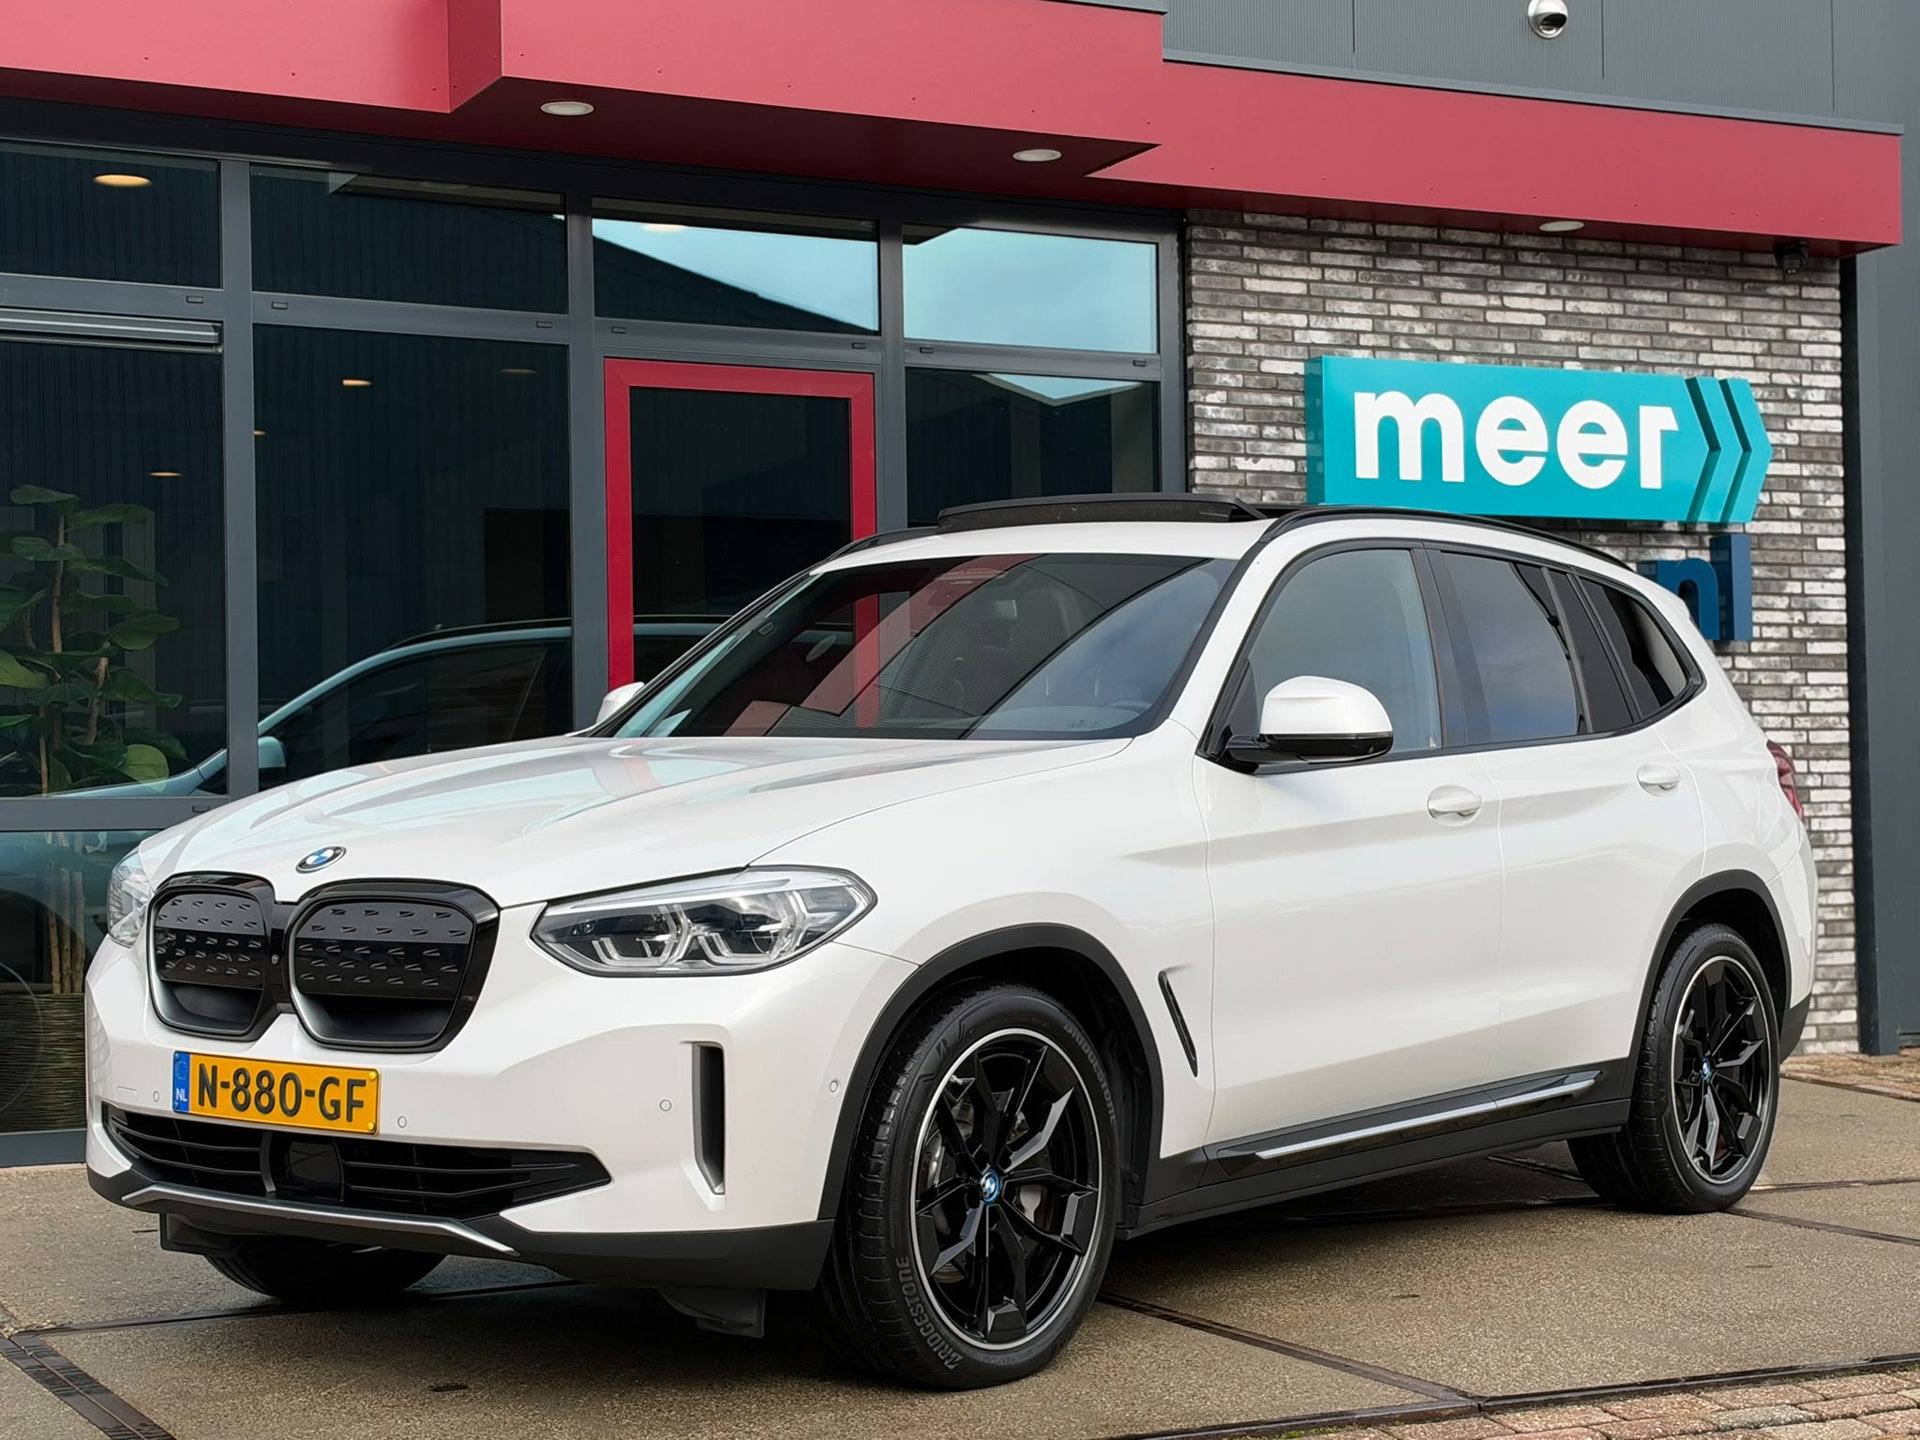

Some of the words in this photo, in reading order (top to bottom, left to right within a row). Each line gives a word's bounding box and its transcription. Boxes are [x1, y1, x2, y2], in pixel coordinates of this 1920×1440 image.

[1354, 391, 1679, 489] meer
[175, 1087, 188, 1102] NL
[198, 1063, 367, 1123] N-880-GF
[1062, 1022, 1117, 1127] BRIDGESTONE
[895, 1255, 965, 1370] BRIDGESTONE
